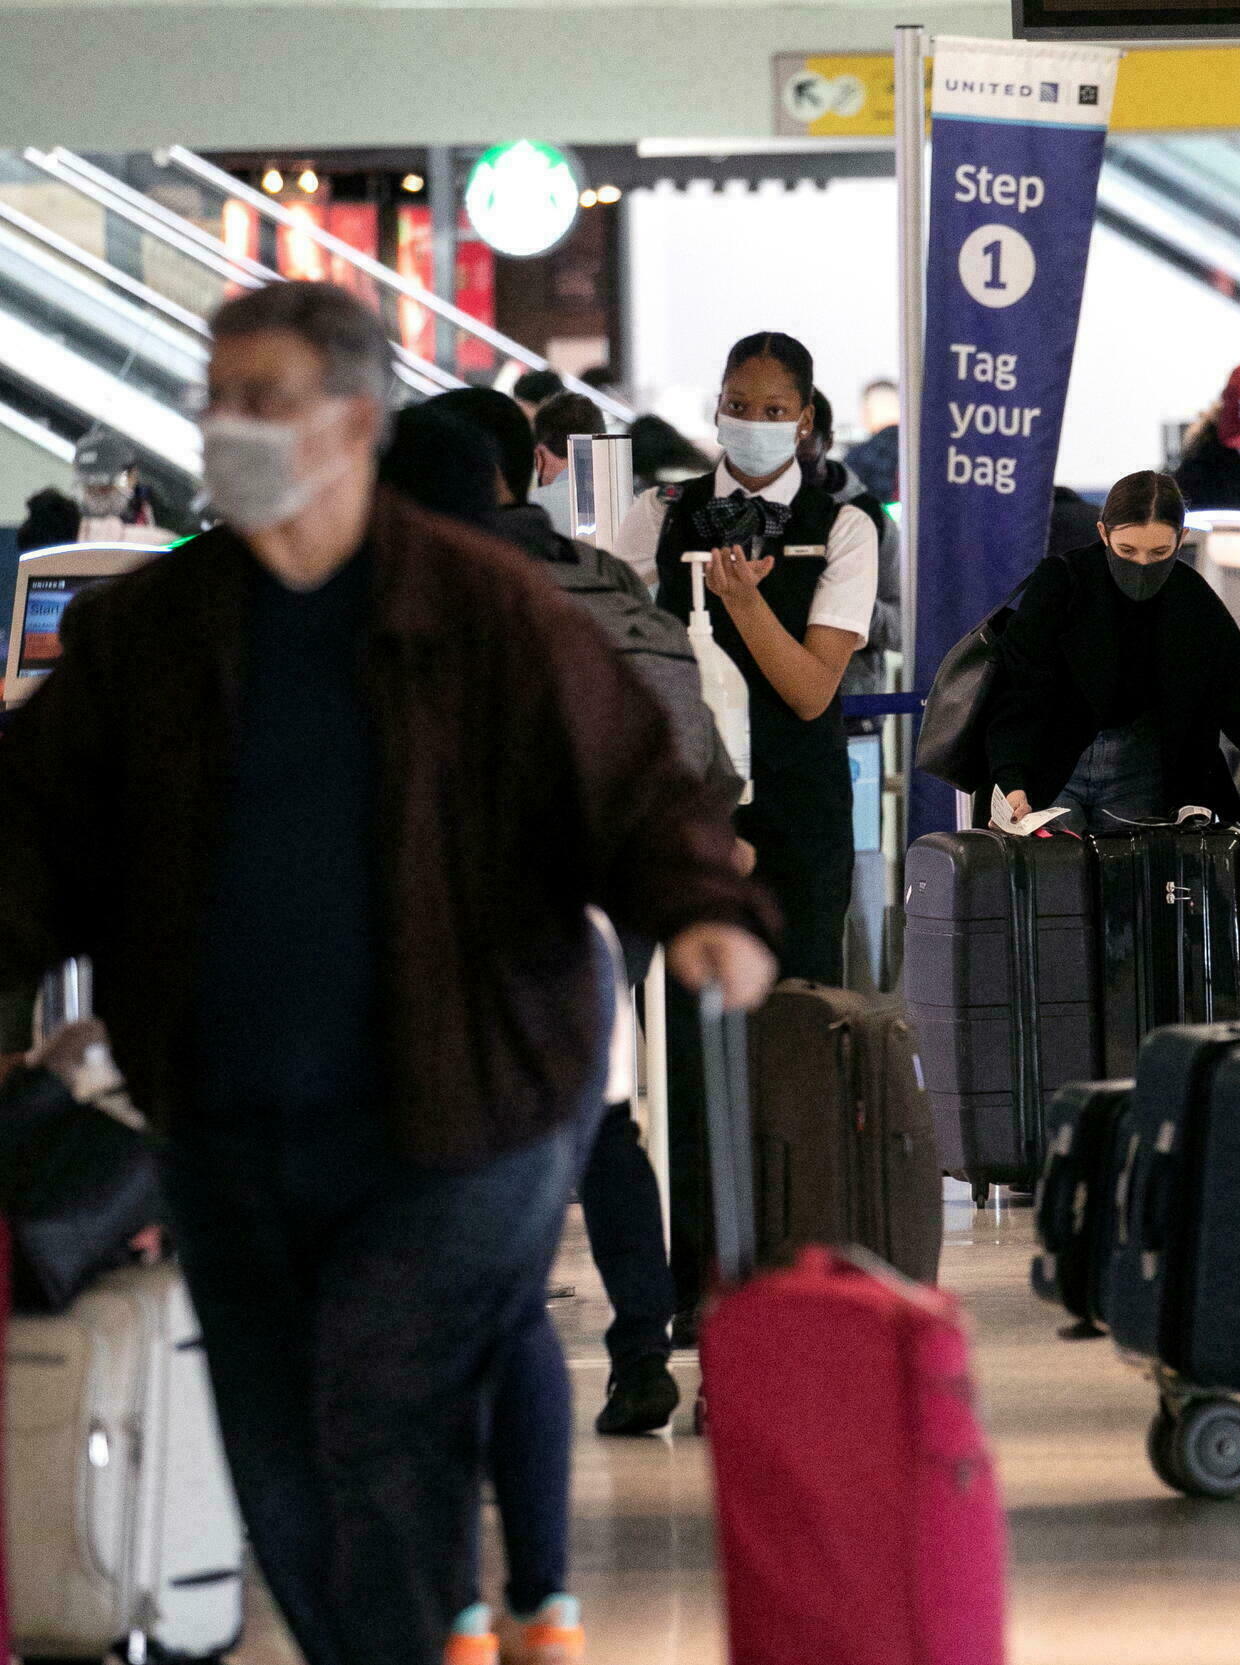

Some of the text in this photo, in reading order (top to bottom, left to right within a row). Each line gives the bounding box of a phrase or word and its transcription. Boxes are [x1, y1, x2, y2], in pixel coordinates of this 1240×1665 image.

[945, 79, 1032, 97] UNITED
[954, 164, 1045, 214] Step
[982, 239, 1007, 290] 1
[950, 343, 1019, 391] Tag
[949, 402, 1041, 439] your
[947, 446, 1017, 495] bag
